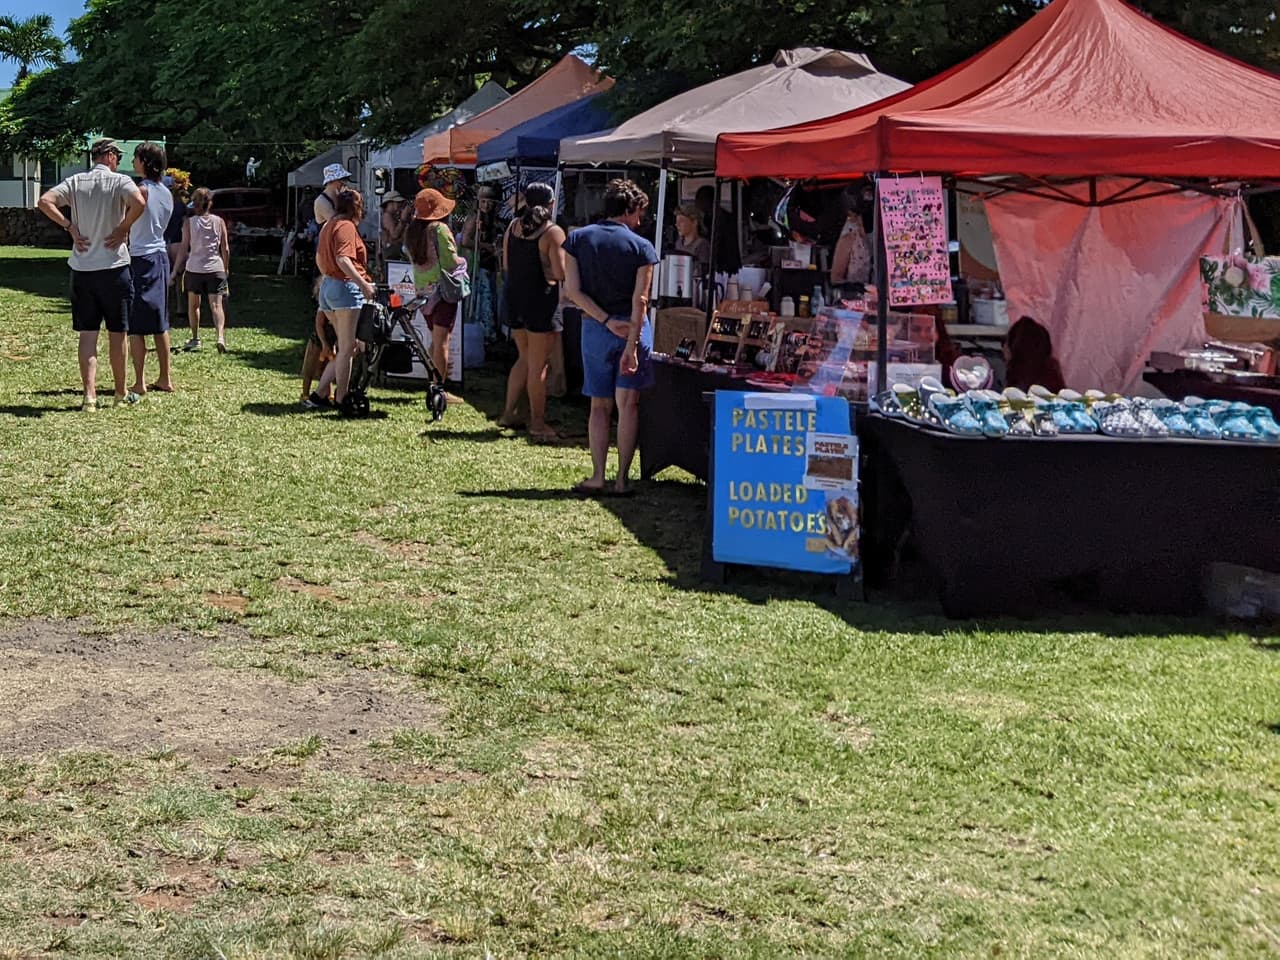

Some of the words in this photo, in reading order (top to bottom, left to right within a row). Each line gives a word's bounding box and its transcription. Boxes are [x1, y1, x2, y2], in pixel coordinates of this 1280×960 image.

[732, 408, 817, 432] PASTELE
[731, 433, 805, 457] PLATES
[729, 480, 809, 504] LOADED
